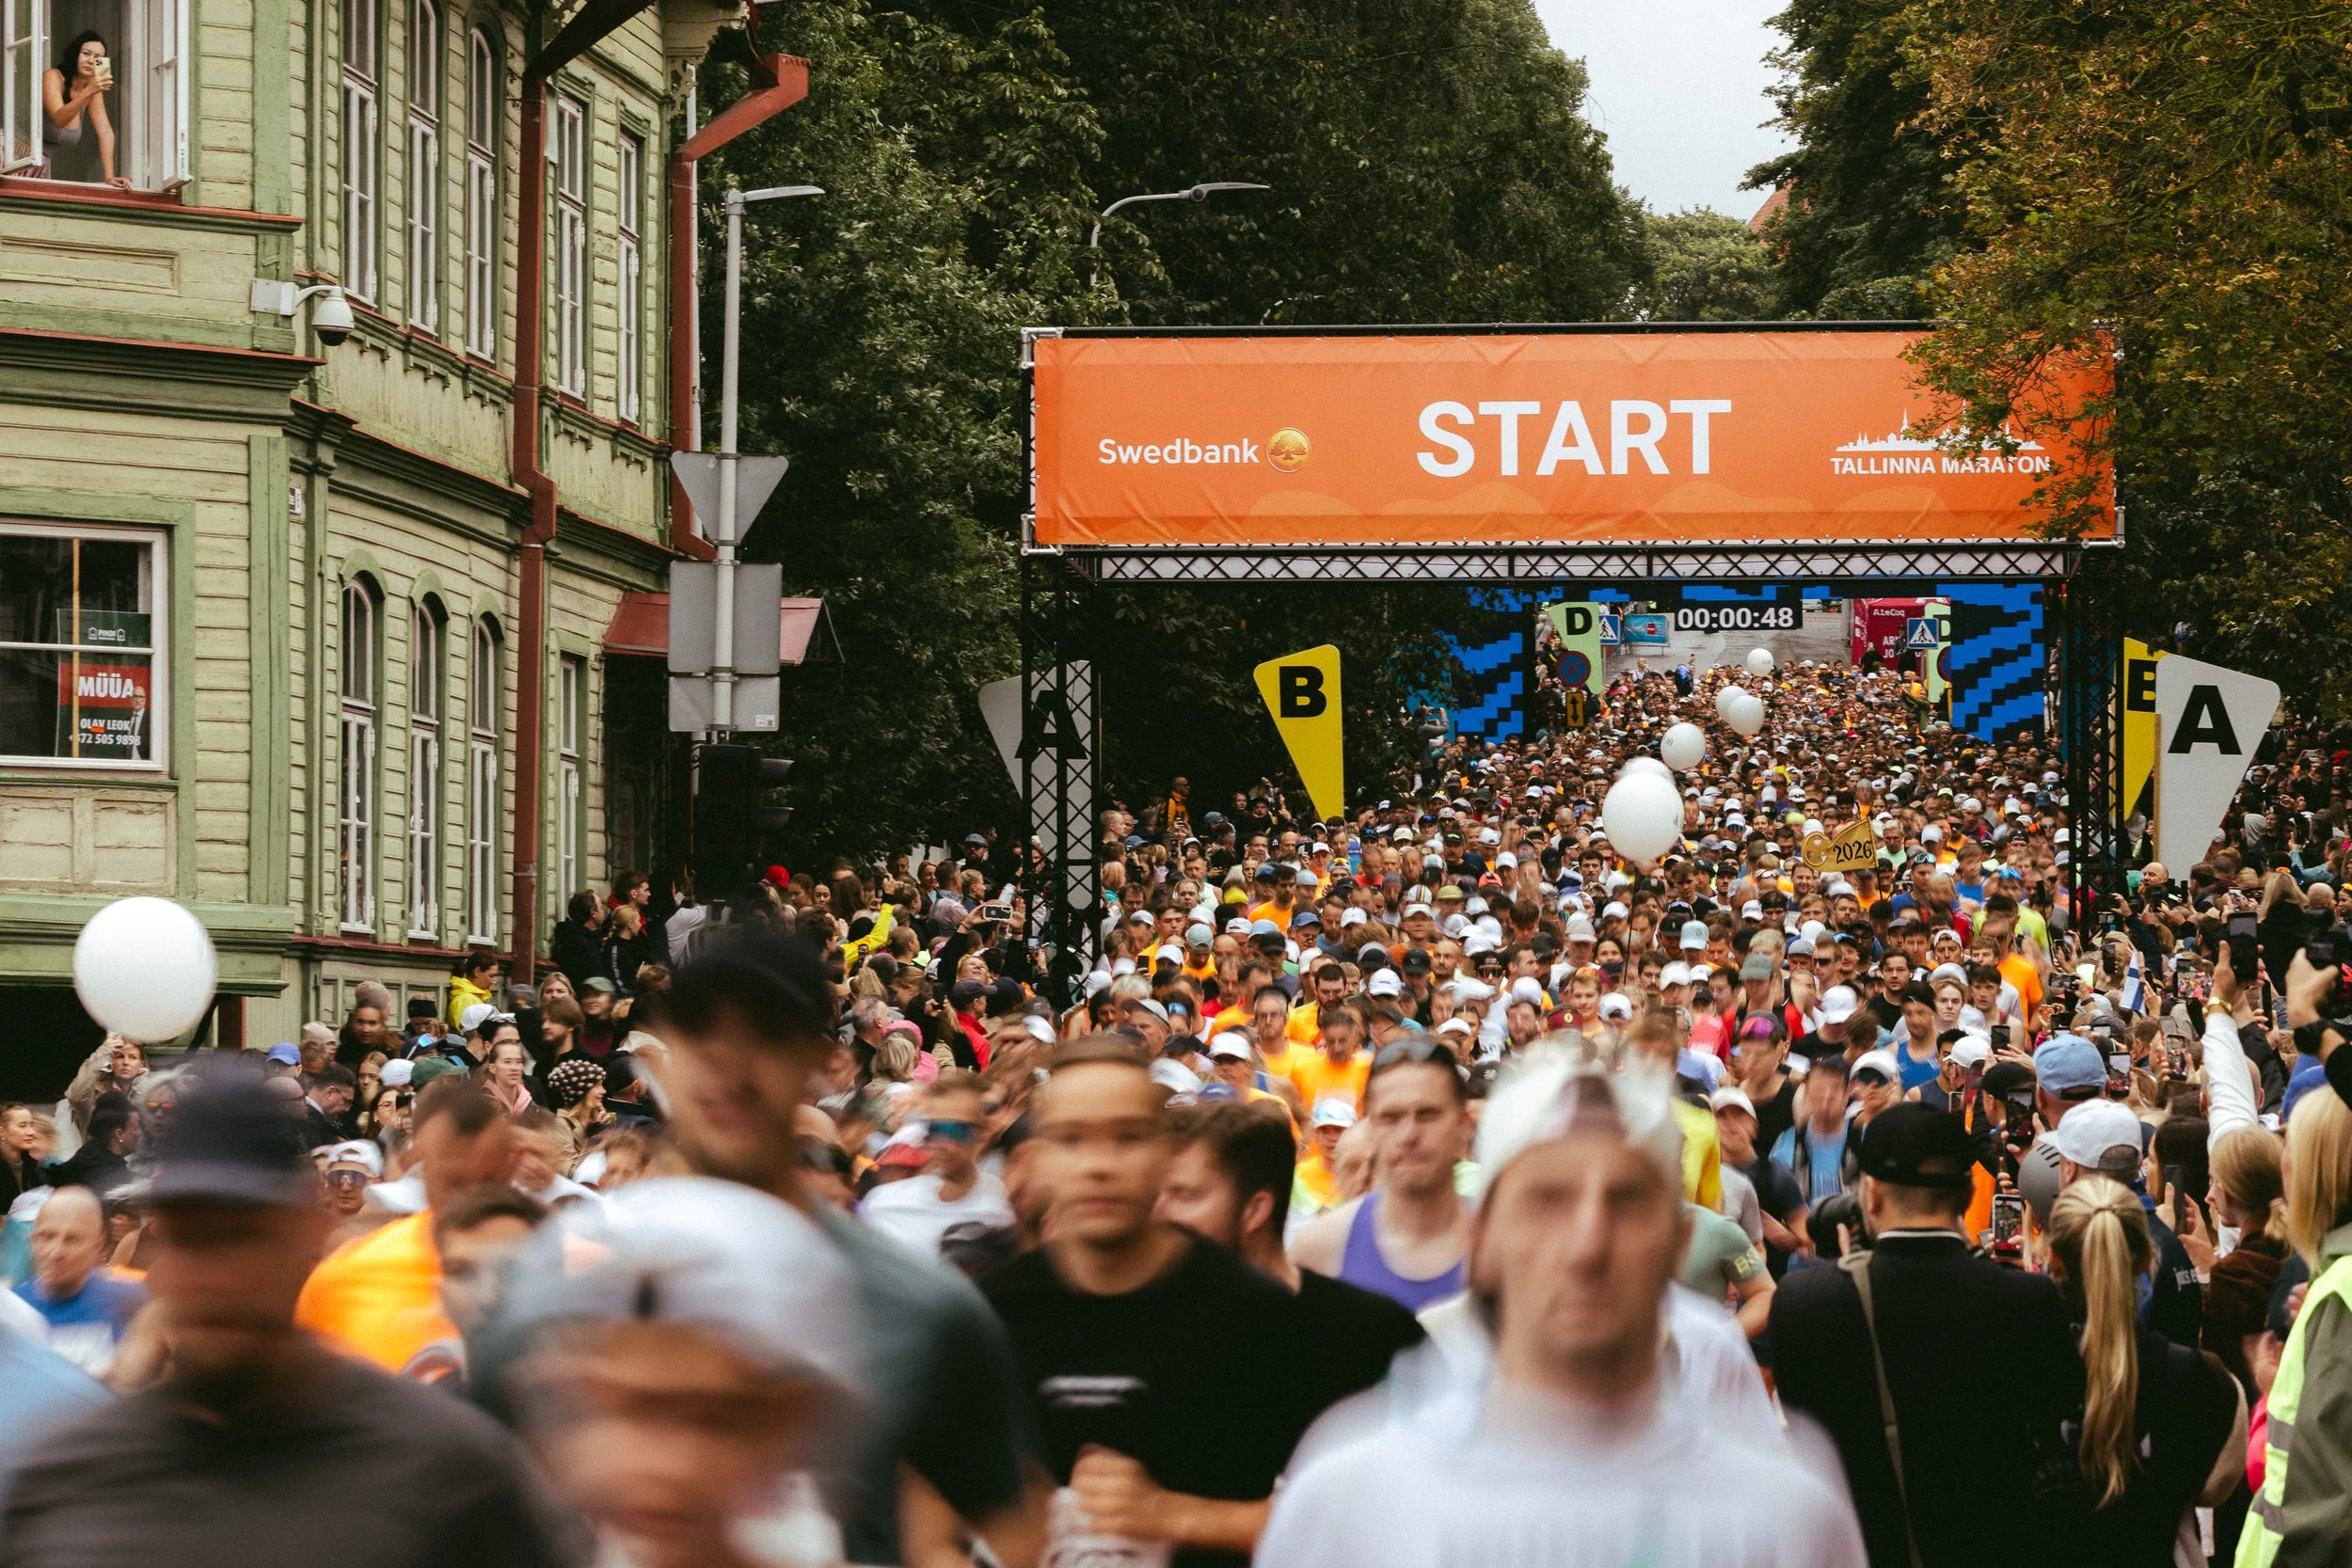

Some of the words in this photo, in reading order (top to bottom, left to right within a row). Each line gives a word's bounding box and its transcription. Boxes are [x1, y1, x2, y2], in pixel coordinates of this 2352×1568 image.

[1098, 437, 1260, 465] Swedbank
[1417, 399, 1732, 478] START
[1829, 456, 1936, 475] TALLINNA
[1941, 455, 2051, 474] MARATON
[1565, 607, 1593, 635] D
[1677, 607, 1794, 628] 00:00:48
[78, 672, 134, 699] MÜÜA
[1279, 665, 1327, 718] B
[80, 719, 106, 729] OLAV
[1014, 689, 1088, 759] A
[2167, 685, 2243, 755] A
[95, 734, 114, 745] 505
[1833, 840, 1873, 864] 2026
